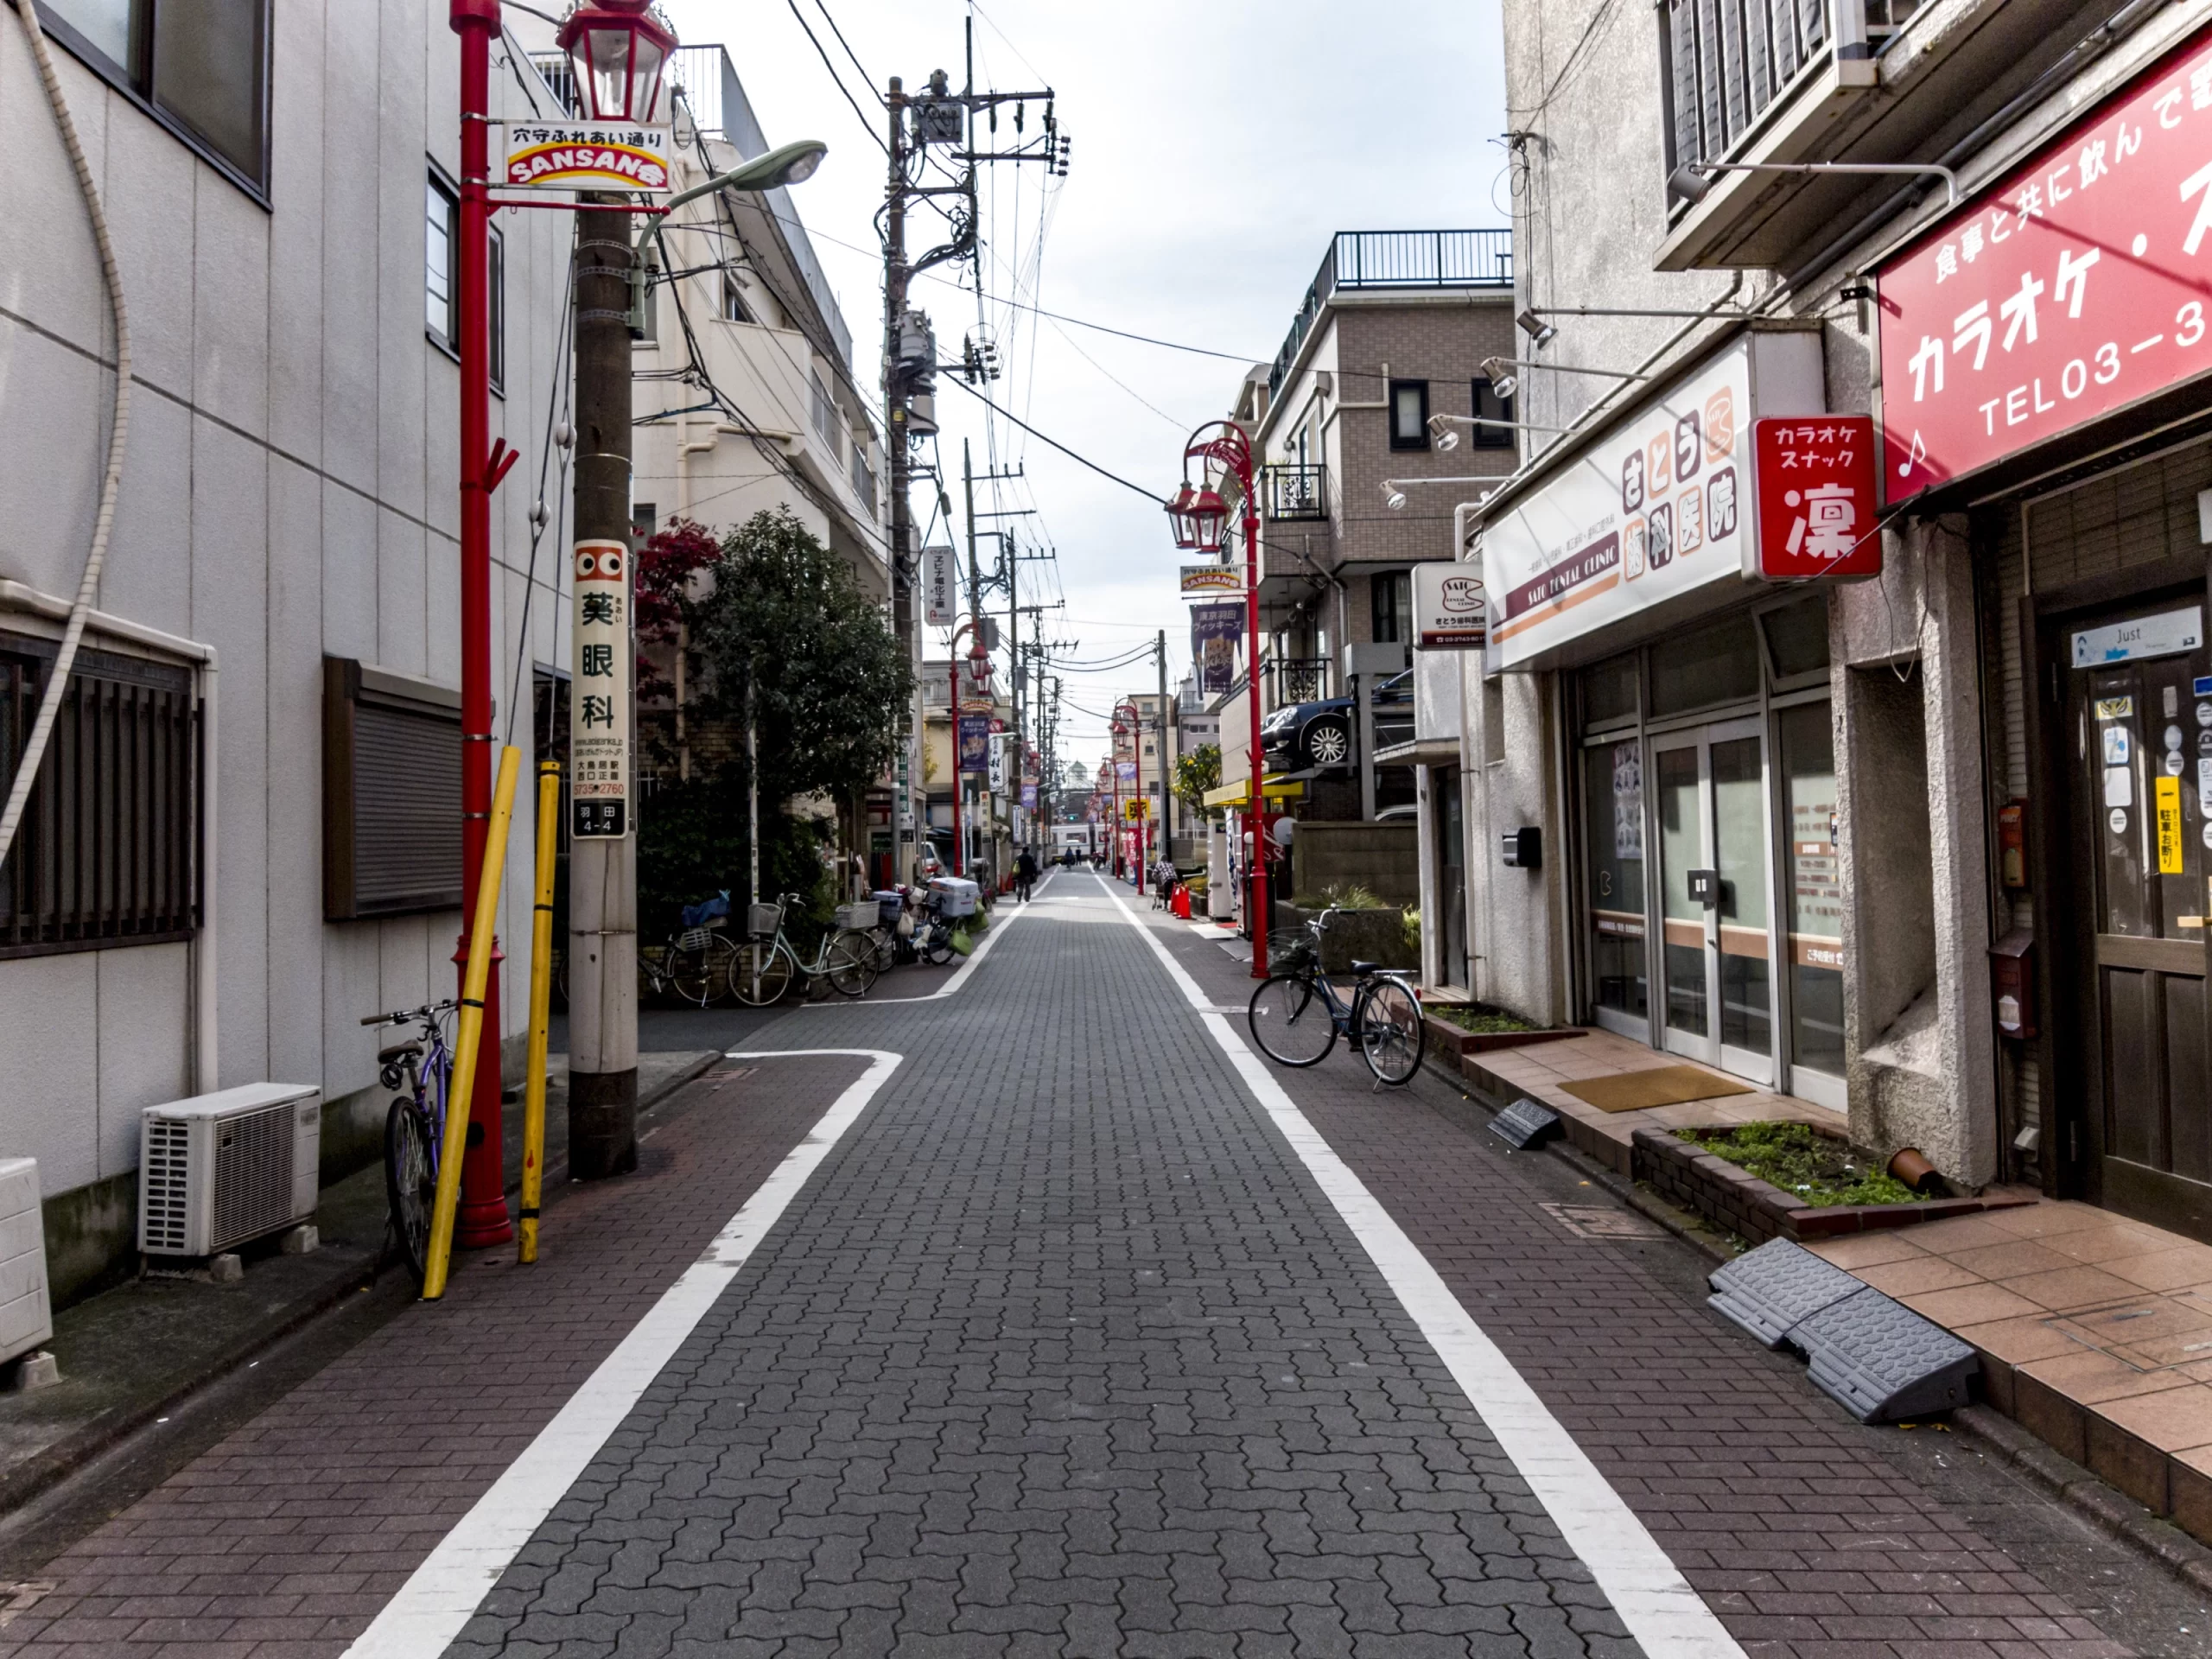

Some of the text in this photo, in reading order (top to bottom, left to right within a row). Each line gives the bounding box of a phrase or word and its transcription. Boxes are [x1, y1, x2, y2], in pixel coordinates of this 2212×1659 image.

[513, 128, 661, 148] 穴守ふれあい通り
[1775, 426, 1857, 445] カラオケ
[1625, 422, 1698, 508] さとう
[1781, 450, 1853, 468] スナック
[1626, 474, 1734, 578] 歯科医院
[1528, 545, 1616, 606] SATO DENTAL CLINIC
[1199, 610, 1236, 620] 東京羽田
[2117, 628, 2140, 644] Just
[582, 592, 614, 729] 葵眼科
[574, 784, 624, 795] 57352760
[581, 806, 615, 817] 羽田
[584, 820, 611, 831] 4-4
